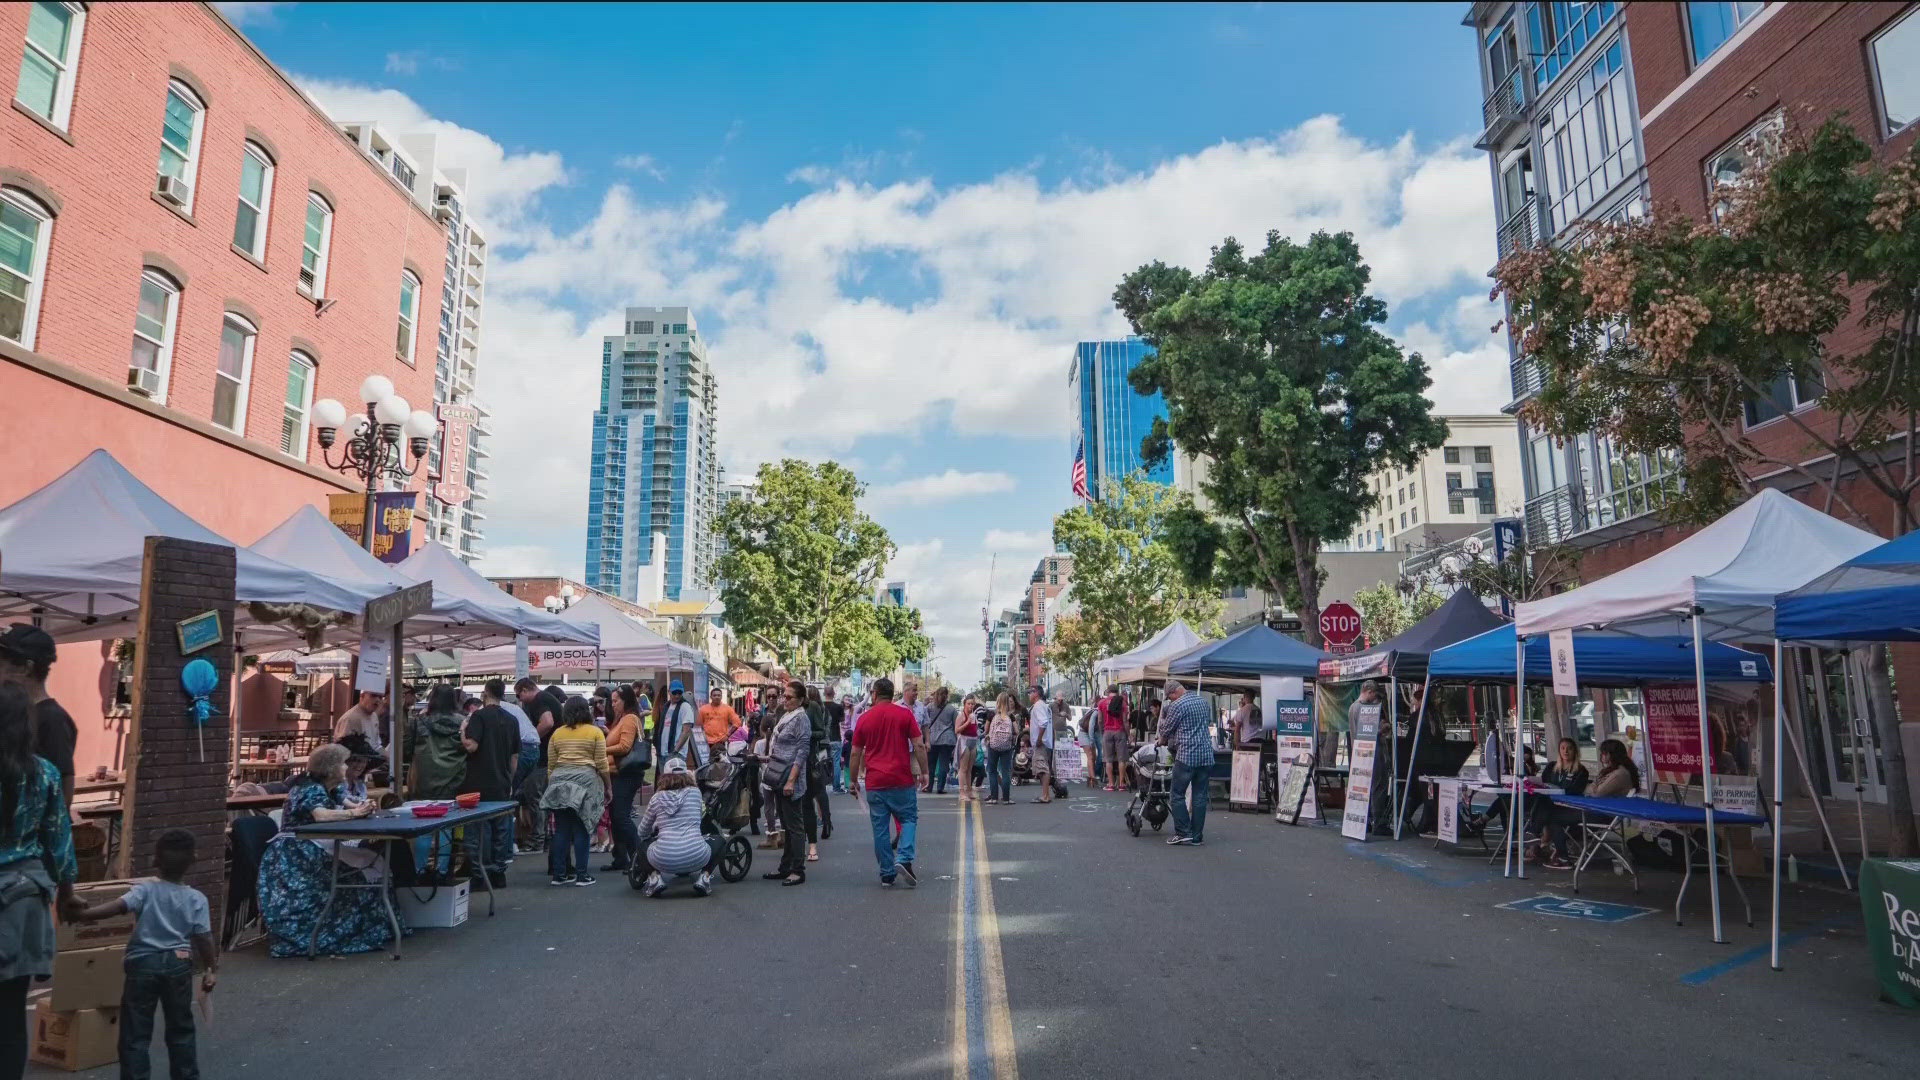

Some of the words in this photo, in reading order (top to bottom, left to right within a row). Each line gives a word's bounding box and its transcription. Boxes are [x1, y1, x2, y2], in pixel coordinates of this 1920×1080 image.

[450, 422, 463, 485] HOTEL
[331, 507, 364, 515] WELCOME
[373, 595, 403, 623] CANDY
[407, 588, 432, 611] STORE
[1321, 616, 1359, 632] STOP
[564, 649, 607, 659] SOLAR
[1648, 689, 1672, 702] SPARE
[1650, 704, 1675, 717] EXTRA
[1675, 703, 1699, 717] MONE
[1713, 789, 1723, 797] NO
[1726, 789, 1757, 798] PARKING
[1882, 891, 1920, 940] Re
